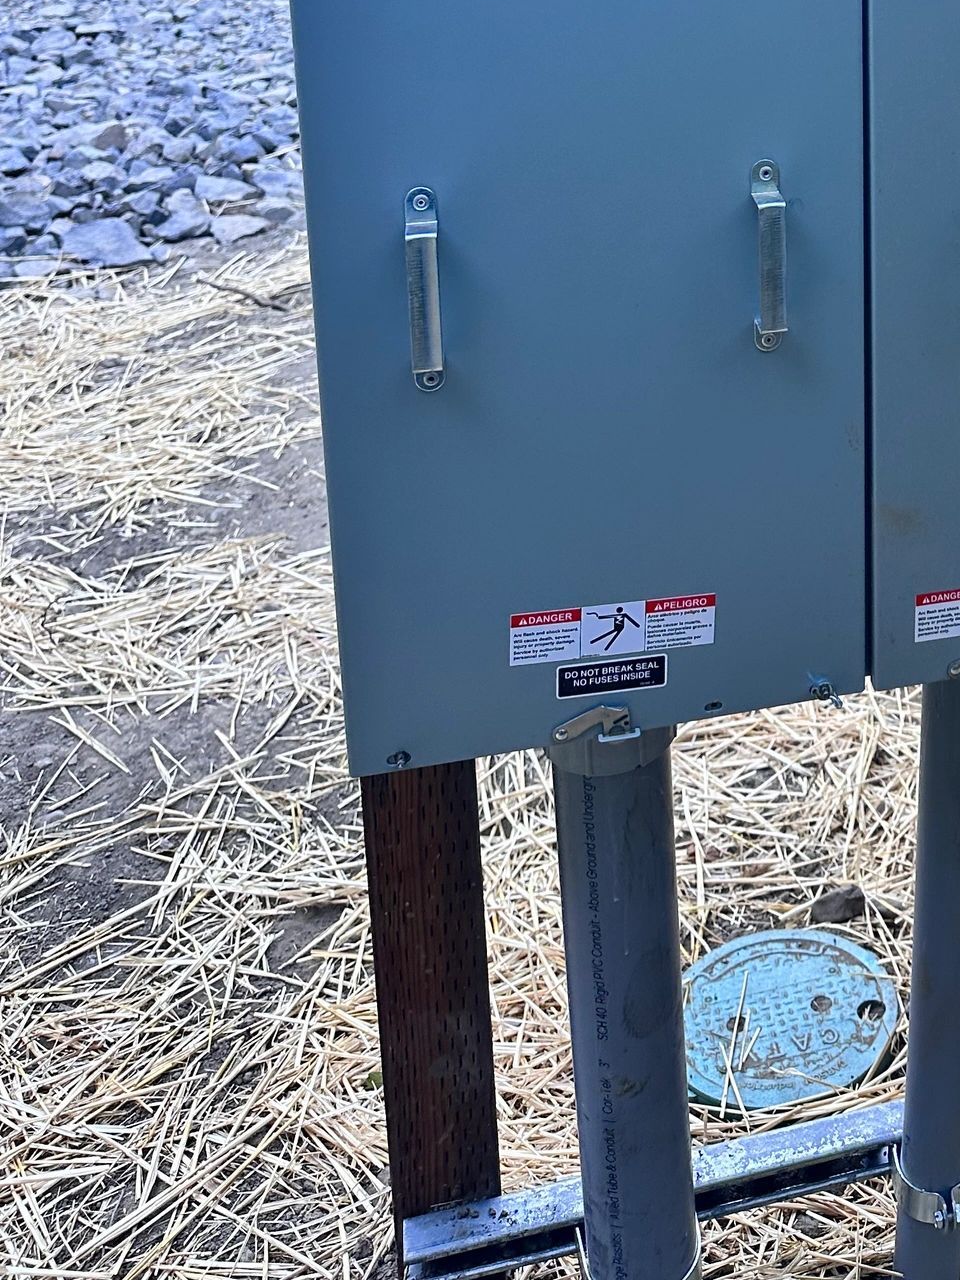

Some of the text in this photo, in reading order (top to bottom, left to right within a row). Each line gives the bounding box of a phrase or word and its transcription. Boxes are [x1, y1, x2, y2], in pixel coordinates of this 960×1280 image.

[663, 597, 707, 609] PELIGRO
[528, 612, 572, 624] DANGER
[565, 661, 659, 679] DO NOT BREAK SEAL
[573, 671, 650, 687] NO FUSES INSIDE
[583, 822, 595, 841] and
[585, 842, 597, 879] Ground
[589, 881, 599, 912] Above
[590, 920, 602, 958] Conduit
[592, 960, 604, 980] PVC
[594, 982, 608, 1004] Rigid
[596, 1008, 606, 1019] 40
[597, 1022, 608, 1041] SCH
[604, 1128, 616, 1163] Conduit
[607, 1173, 618, 1194] Tube
